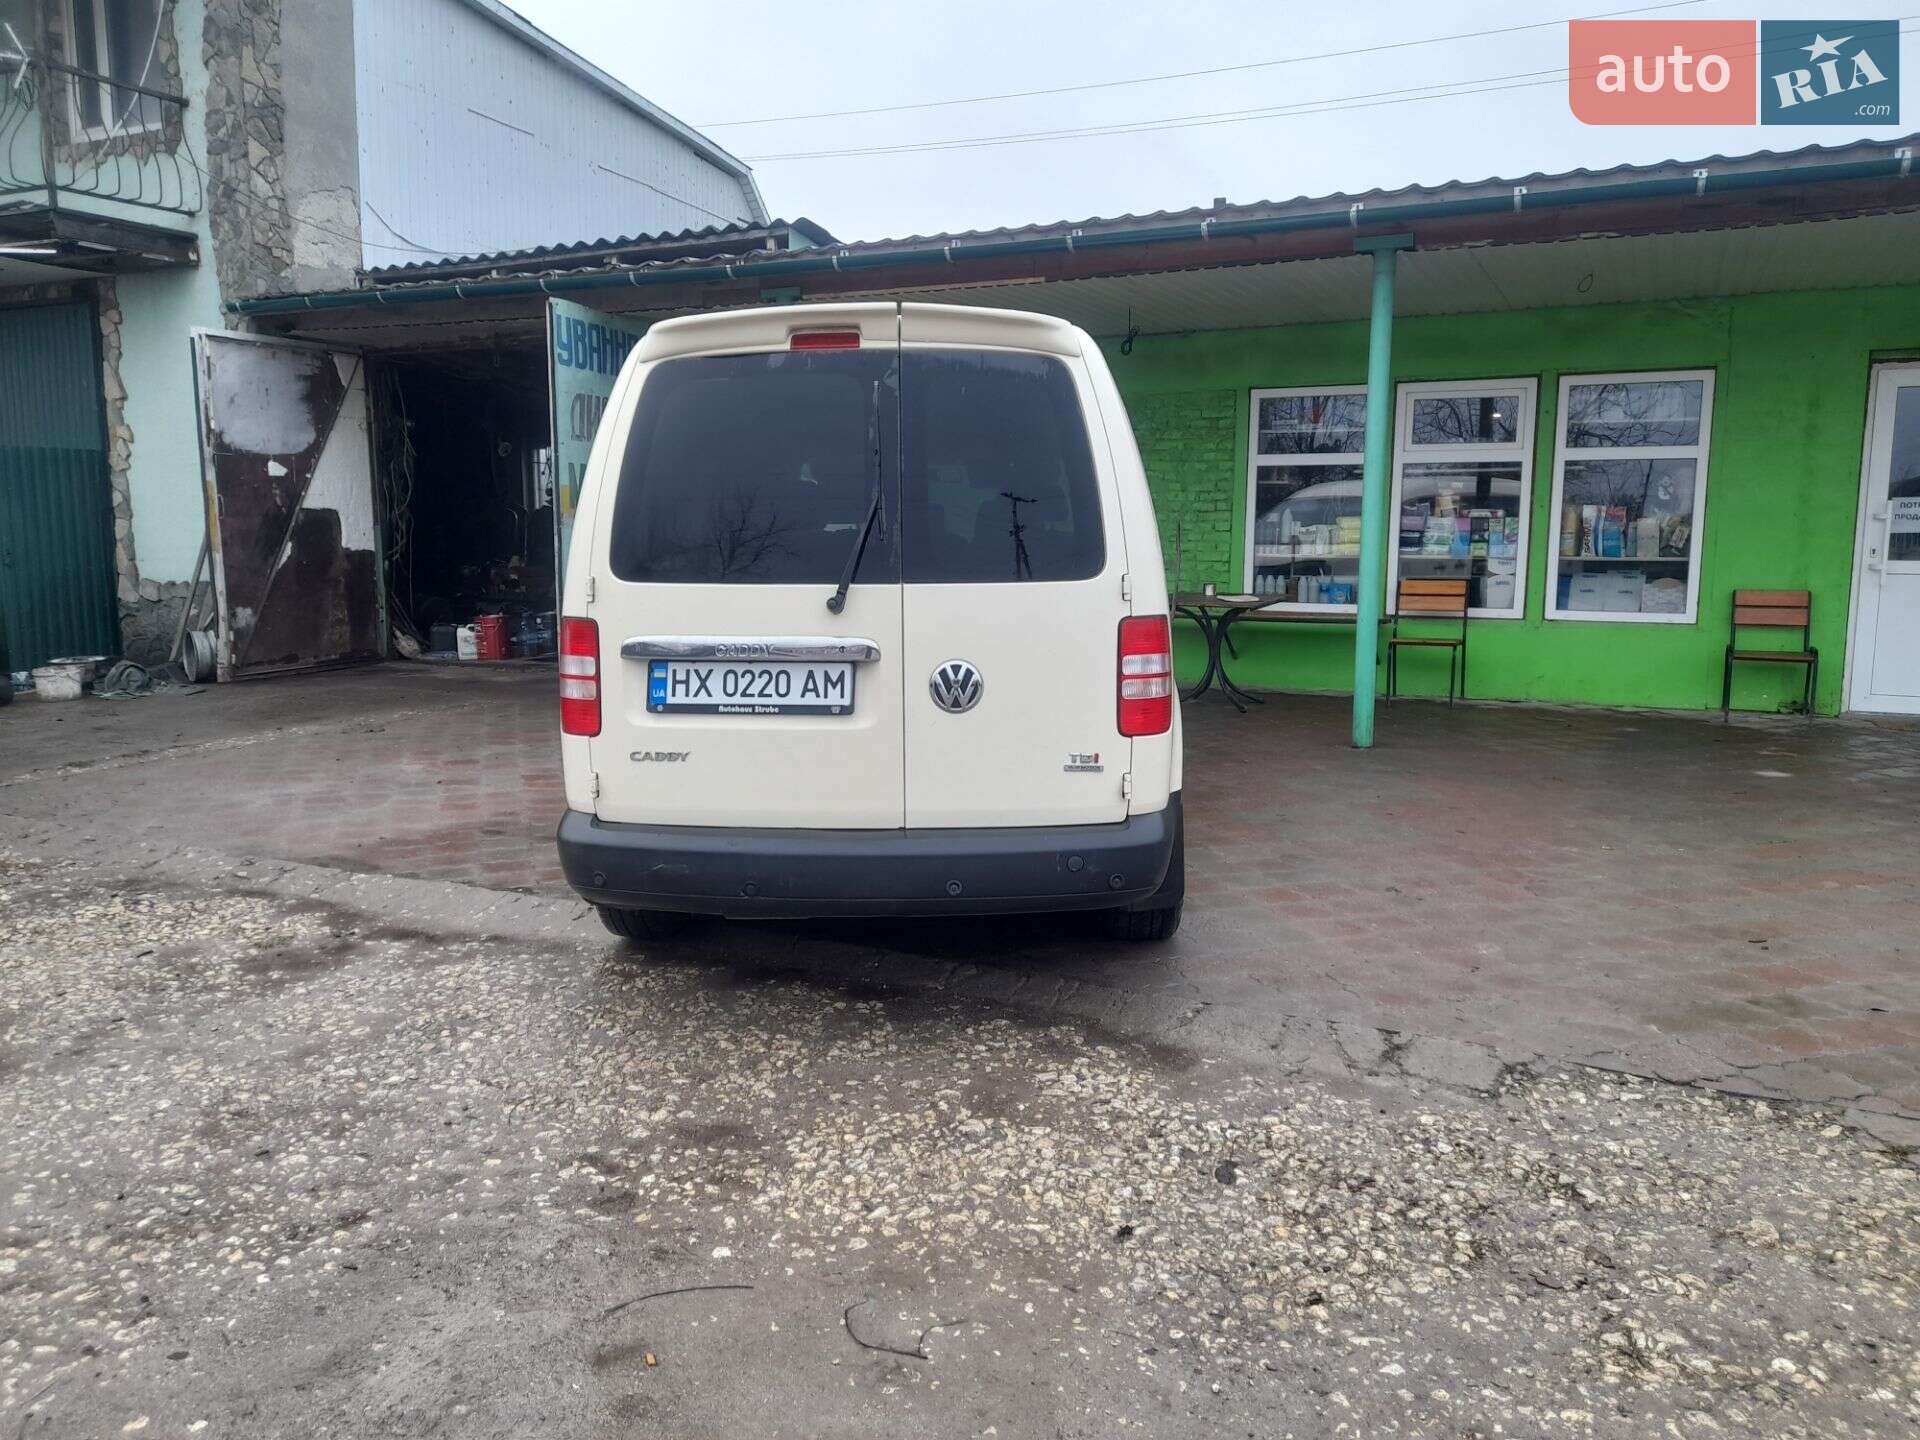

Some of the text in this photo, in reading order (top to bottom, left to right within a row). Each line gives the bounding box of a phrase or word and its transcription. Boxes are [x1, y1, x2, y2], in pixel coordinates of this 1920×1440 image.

[570, 392, 609, 442] ДИ
[1894, 513, 1920, 521] ПРОД
[714, 643, 774, 658] CADDY
[671, 668, 845, 699] HX 0220 AM
[652, 689, 666, 699] UA
[718, 705, 753, 713] Autohaus
[629, 751, 691, 762] CADDY
